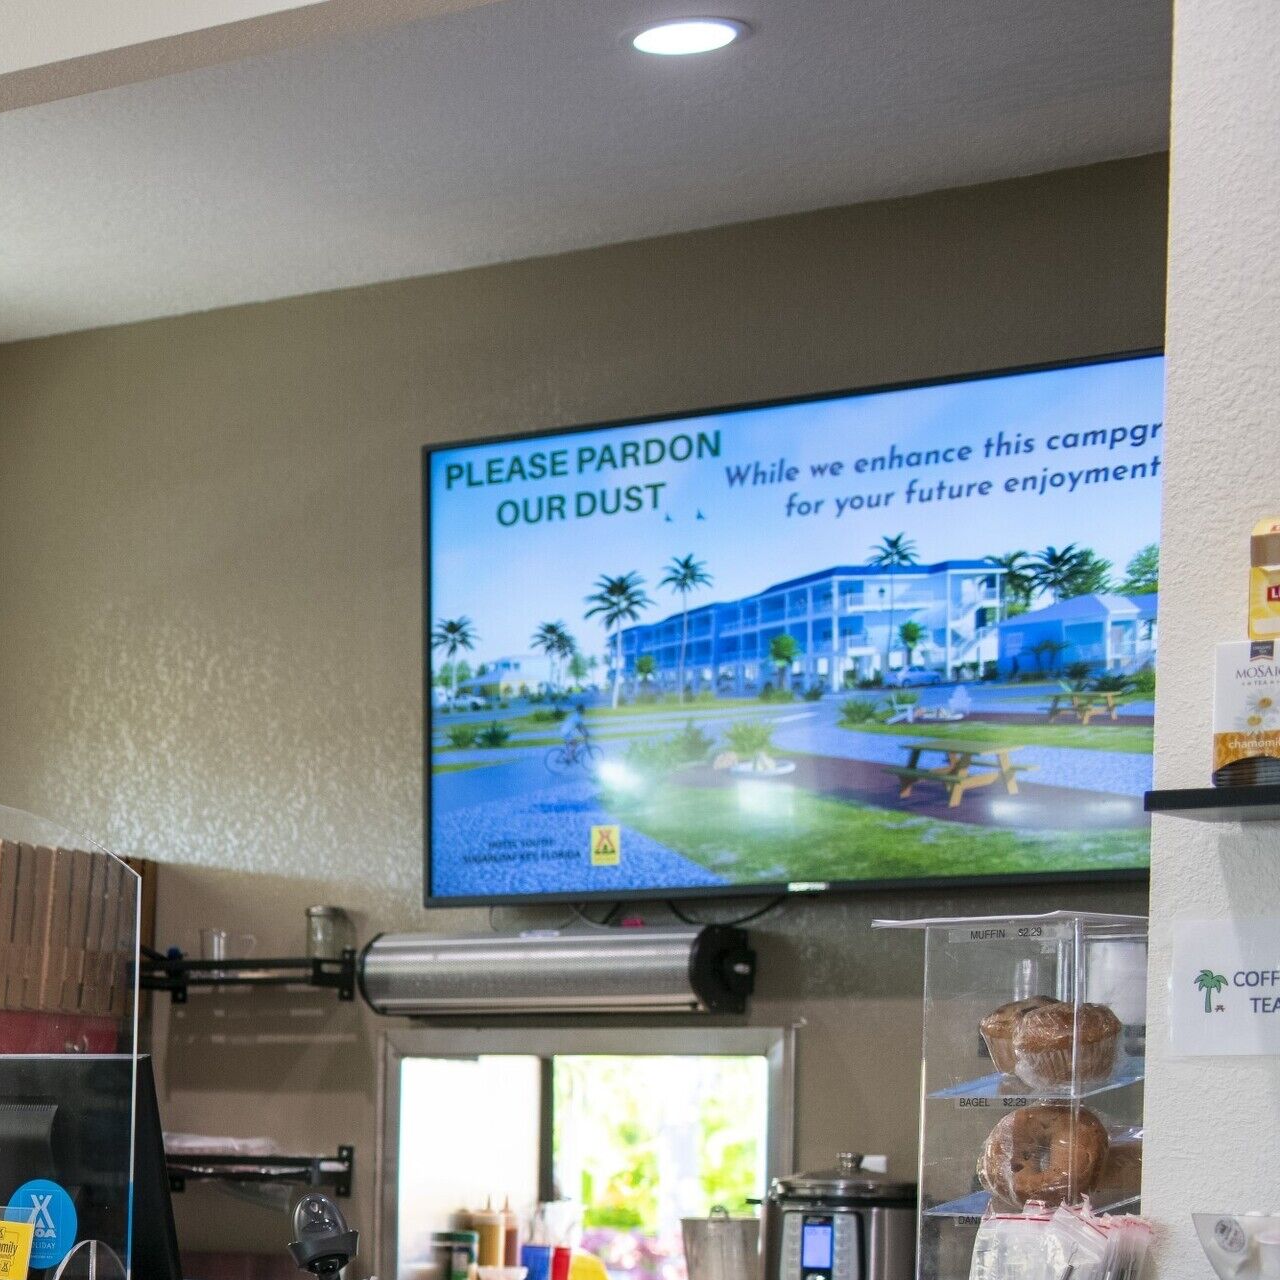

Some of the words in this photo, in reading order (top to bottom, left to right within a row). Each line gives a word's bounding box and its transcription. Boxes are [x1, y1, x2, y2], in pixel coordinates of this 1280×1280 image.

[445, 449, 568, 491] PLEASE
[577, 429, 721, 474] PARDON
[725, 459, 800, 489] While
[809, 459, 844, 479] we
[854, 444, 973, 473] enhance
[984, 431, 1035, 459] this
[496, 495, 567, 527] OUR
[576, 482, 667, 518] DUST
[786, 492, 825, 518] for
[835, 487, 896, 519] your
[905, 478, 994, 506] future
[1004, 455, 1162, 496] enjoyment
[970, 929, 1006, 940] MUFFIN
[1018, 927, 1042, 938] $2.29
[1233, 971, 1280, 987] COFF
[959, 1097, 990, 1107] BAGEL
[1003, 1097, 1027, 1107] $2.29
